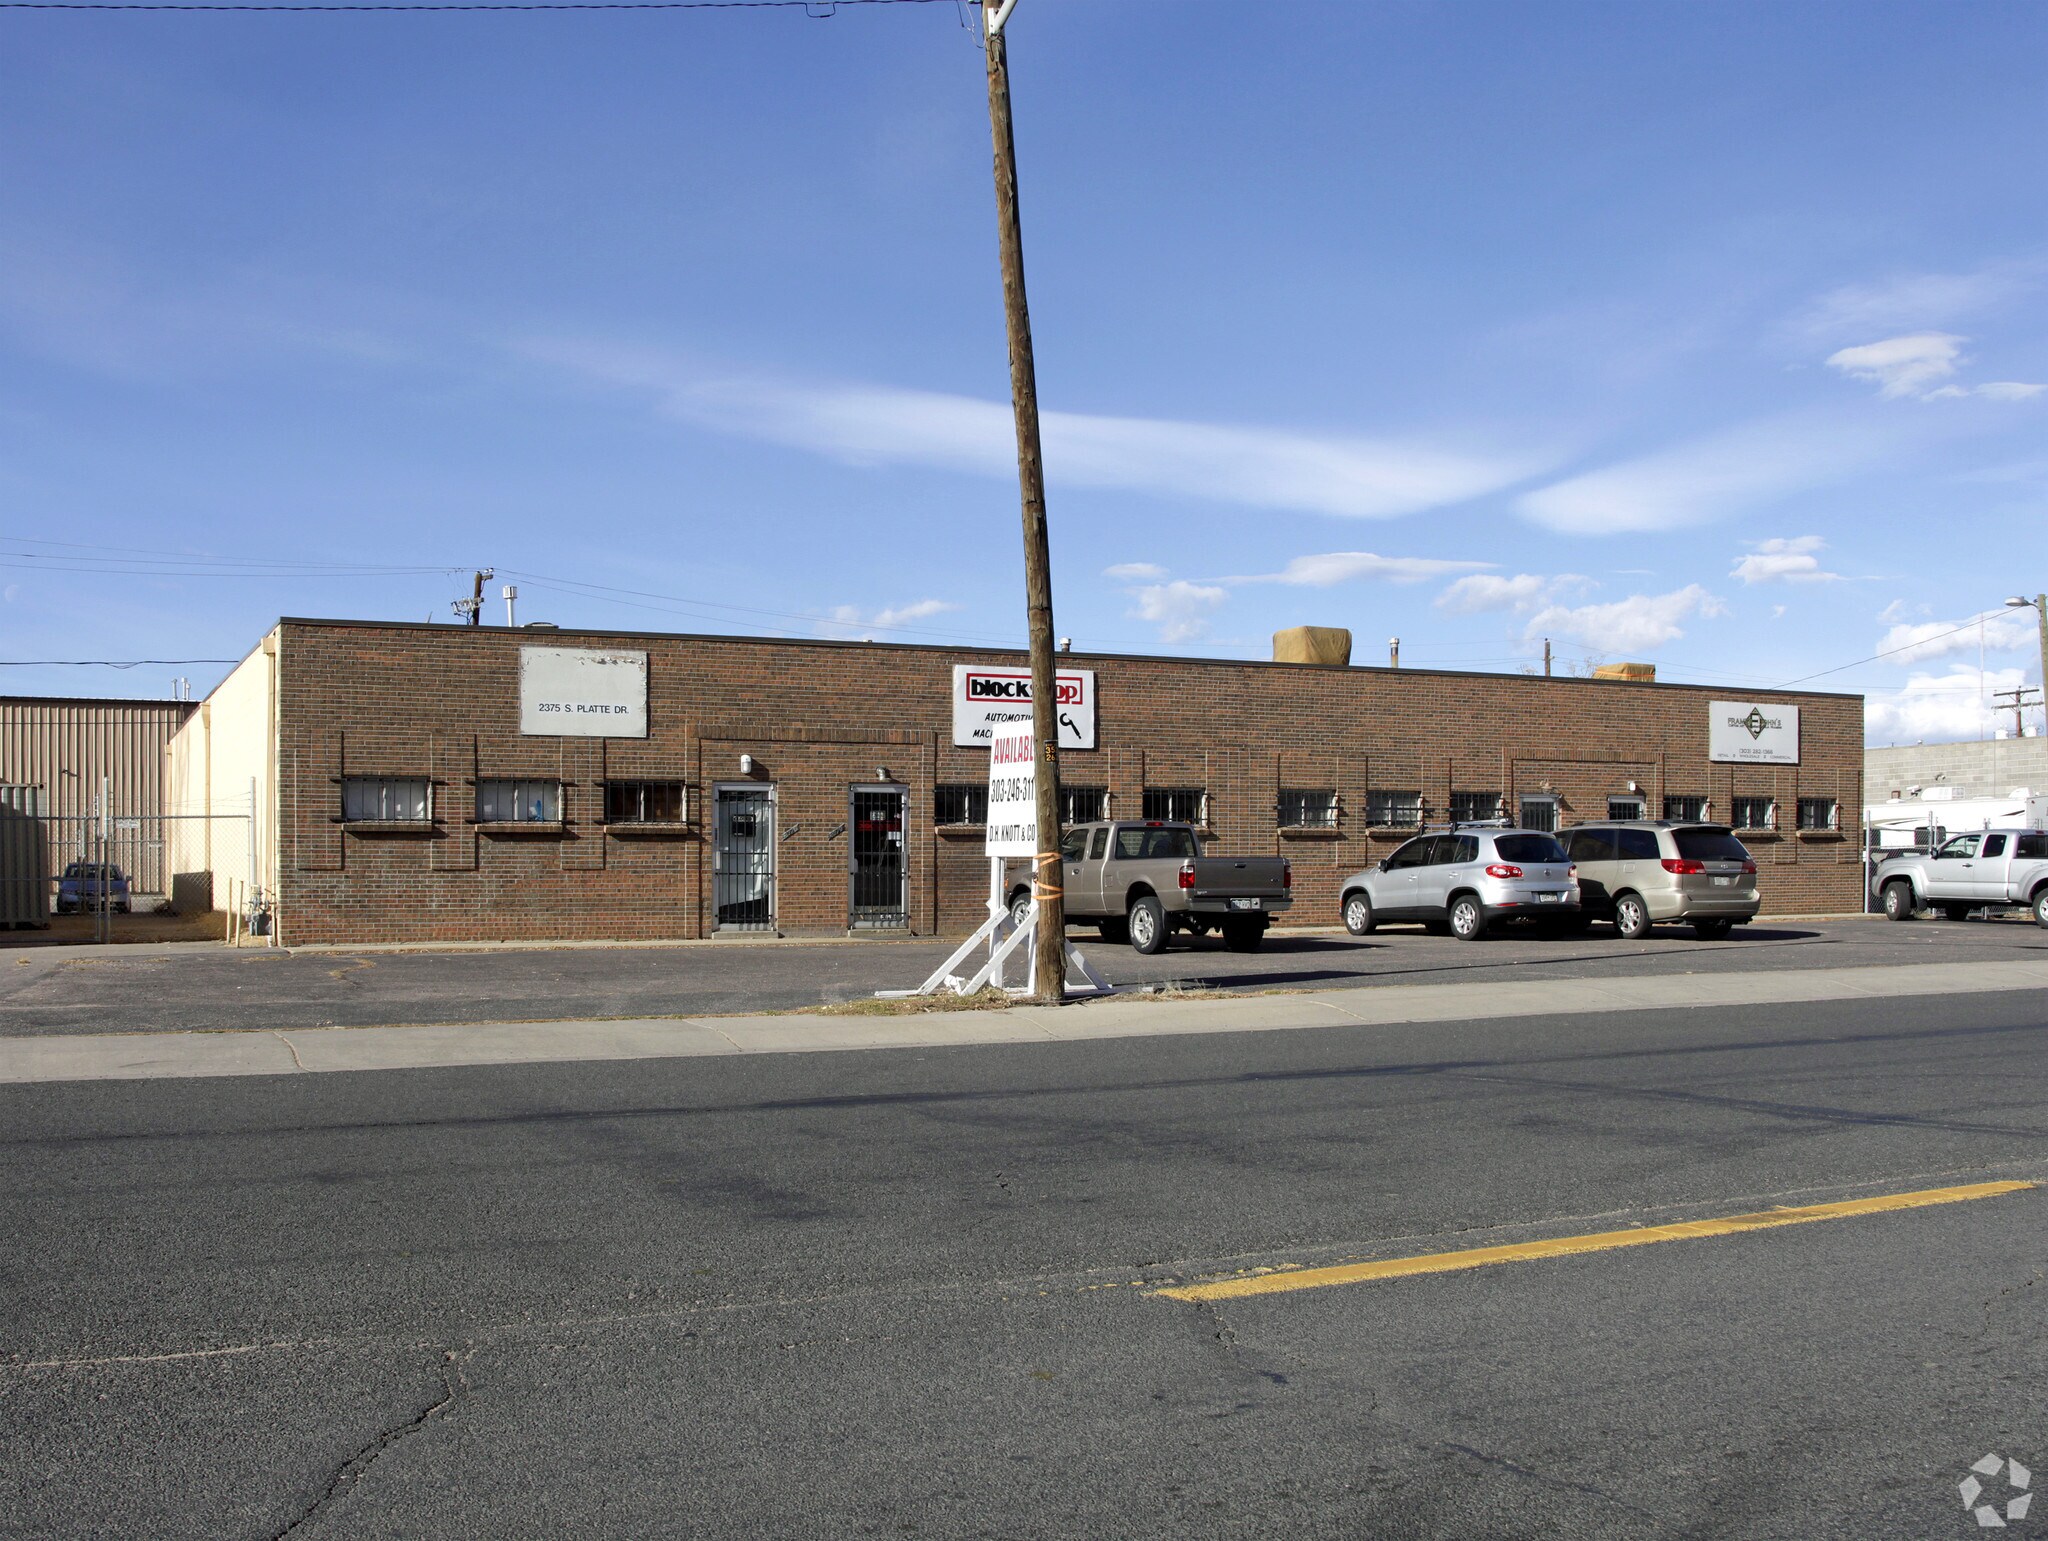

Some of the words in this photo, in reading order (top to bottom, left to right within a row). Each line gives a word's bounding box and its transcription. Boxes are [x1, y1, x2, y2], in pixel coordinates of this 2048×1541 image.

[538, 703, 561, 712] 2375
[564, 704, 573, 713] S.
[577, 705, 611, 714] PLATTE
[614, 706, 629, 714] DR.
[1001, 823, 1021, 842] KNOTT
